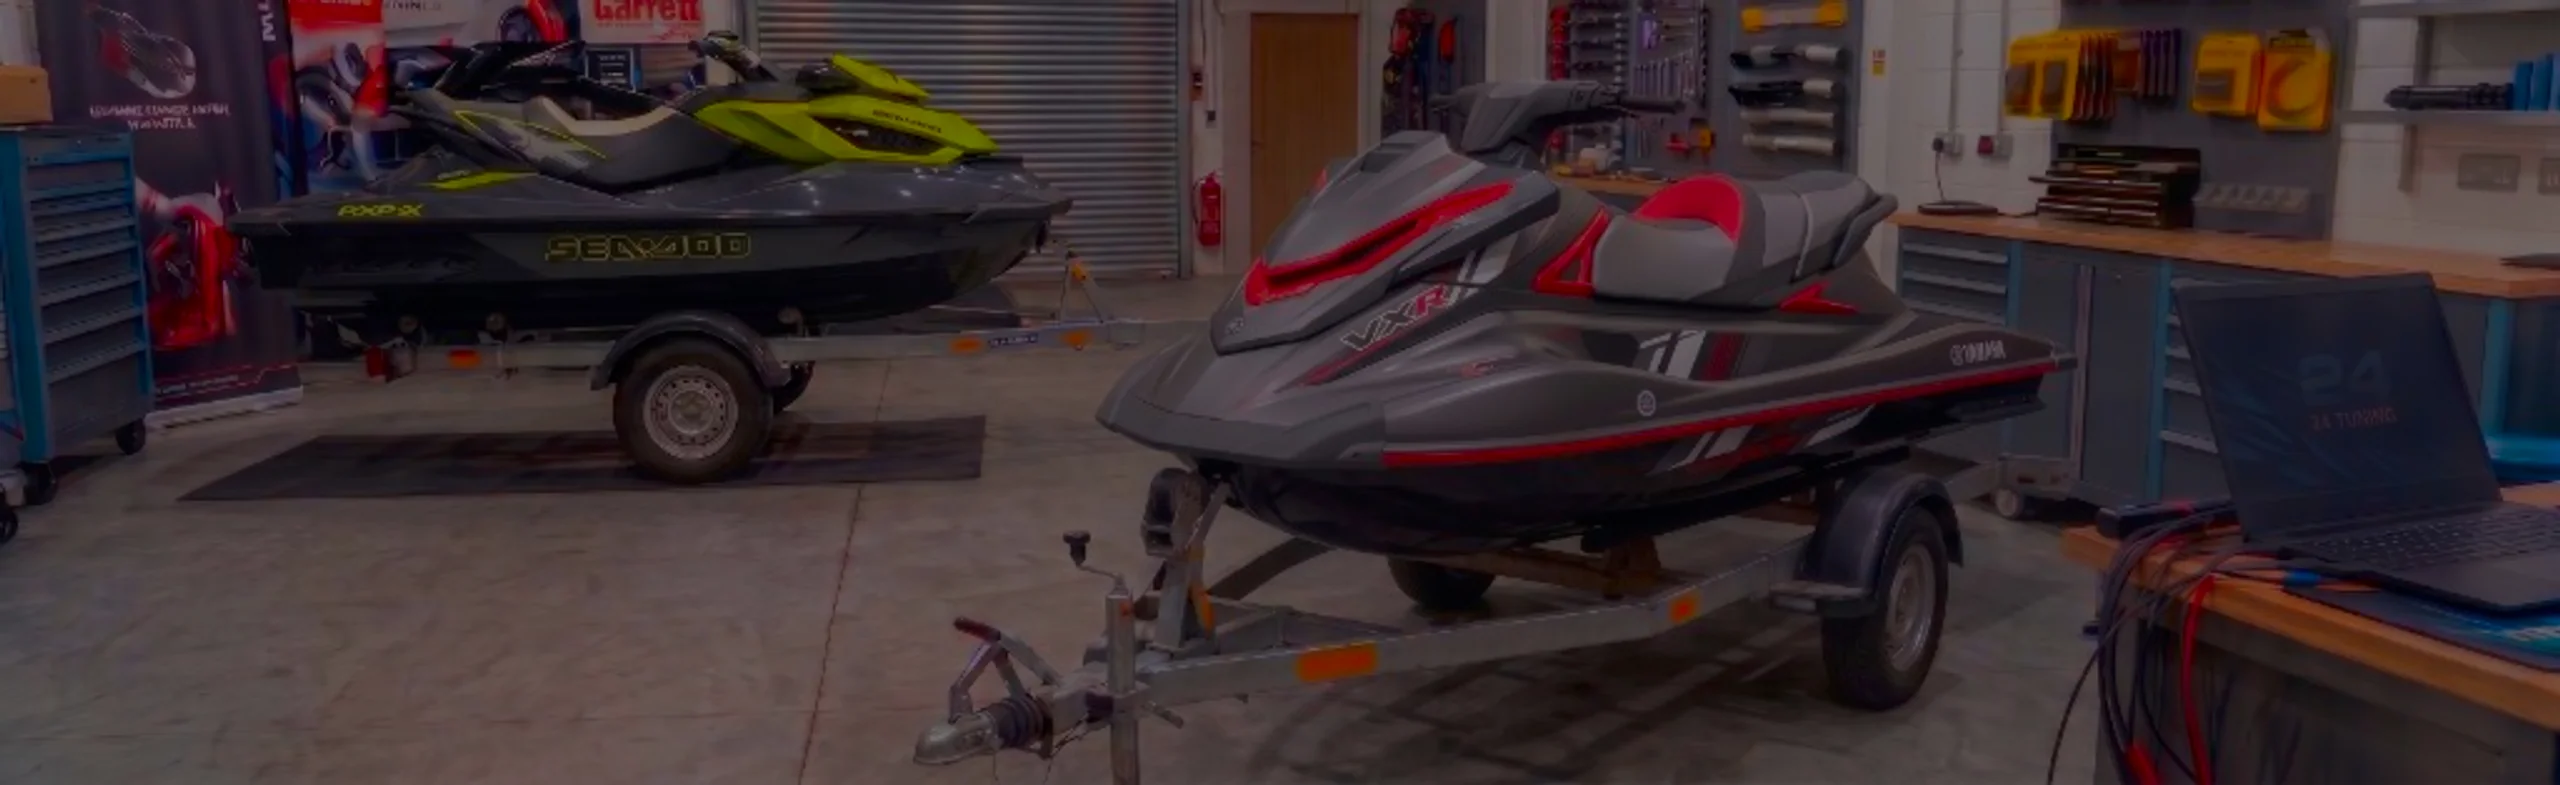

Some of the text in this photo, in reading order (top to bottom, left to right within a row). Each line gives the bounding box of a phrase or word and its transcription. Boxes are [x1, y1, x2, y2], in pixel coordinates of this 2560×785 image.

[594, 0, 702, 21] Garrett
[1340, 282, 1454, 351] VXR
[2297, 349, 2392, 406] 24
